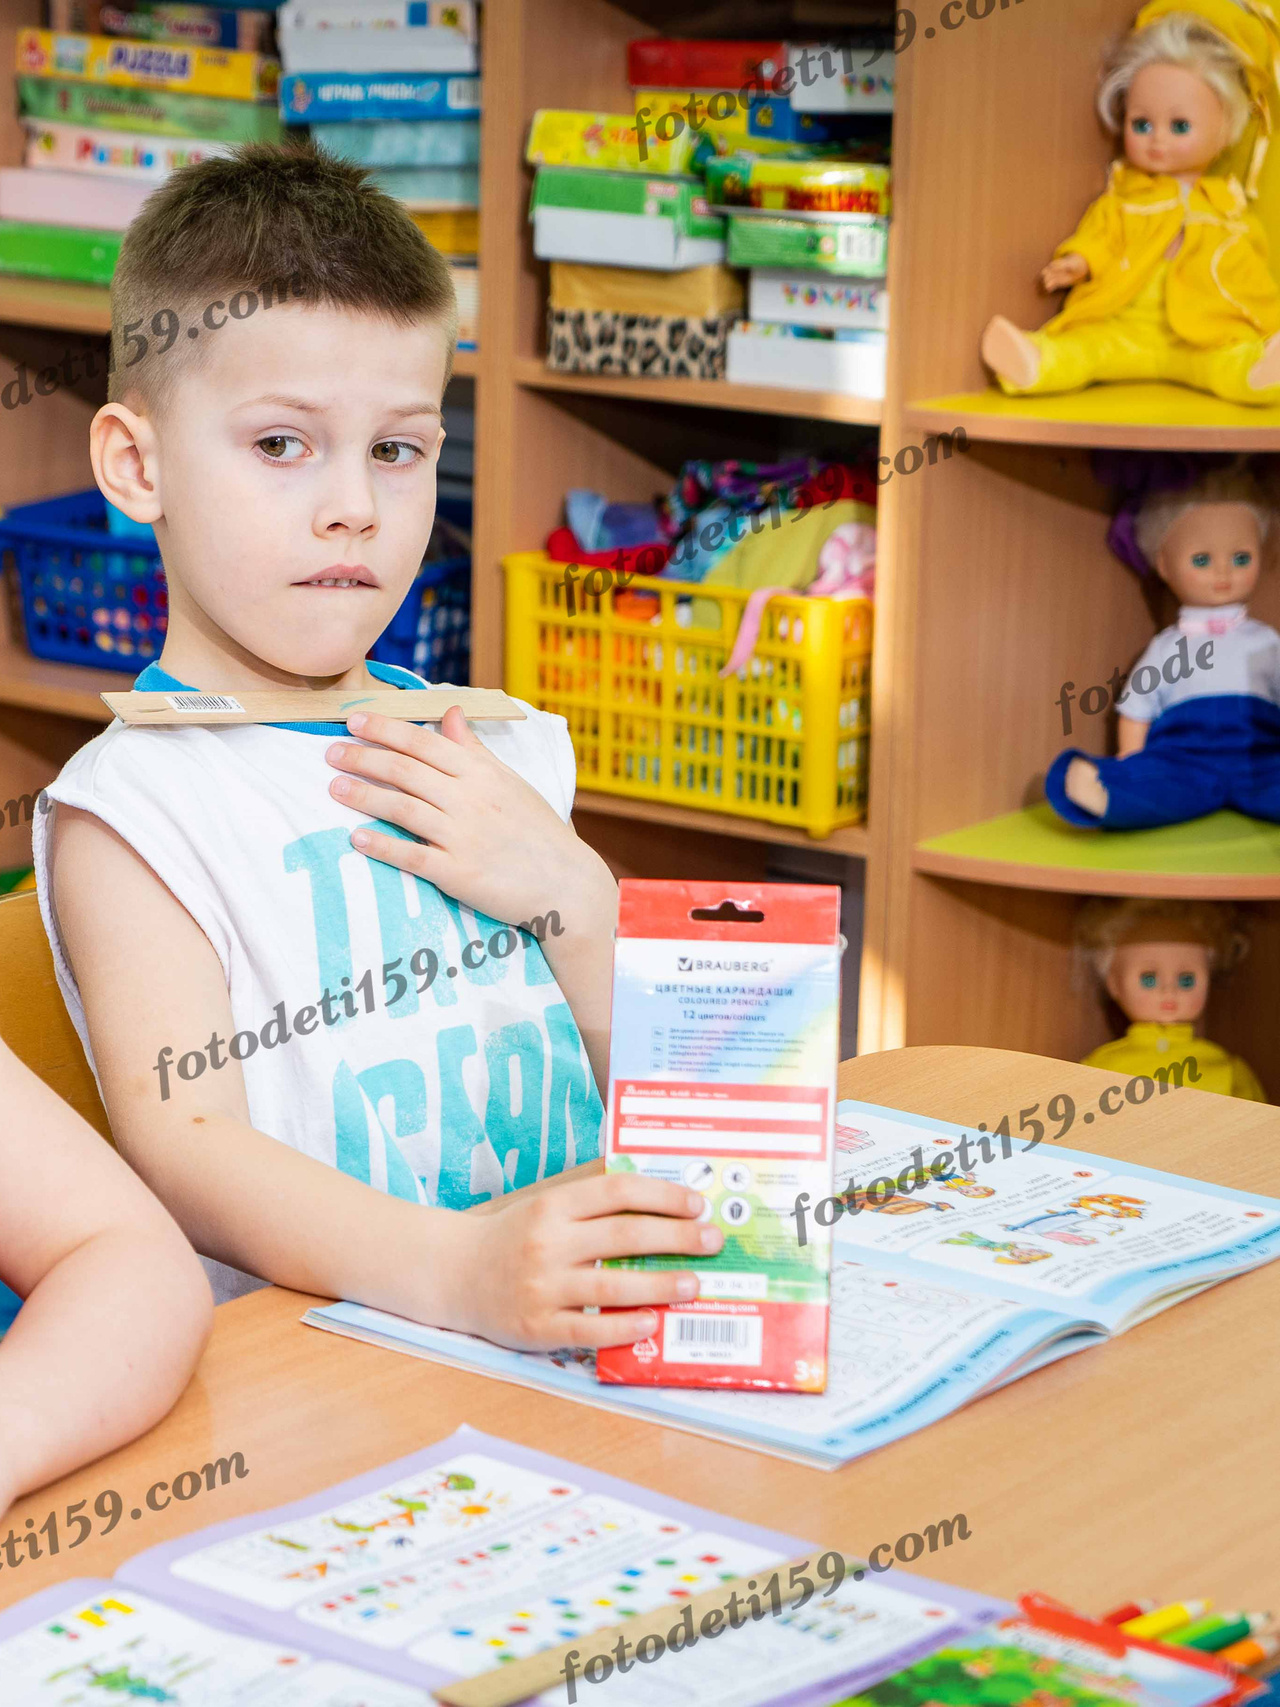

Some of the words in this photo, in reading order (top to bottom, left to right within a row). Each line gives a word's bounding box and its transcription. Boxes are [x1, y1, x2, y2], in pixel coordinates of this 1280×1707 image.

[695, 959, 770, 973] BRAUBERG
[655, 983, 712, 994] ЦВЕТНЫЕ
[715, 985, 794, 997] КАРАНДАШИ
[677, 996, 728, 1005] COLOURED
[730, 999, 770, 1007] PENCILS
[683, 1009, 696, 1019] 12
[793, 1359, 822, 1382] 3+
